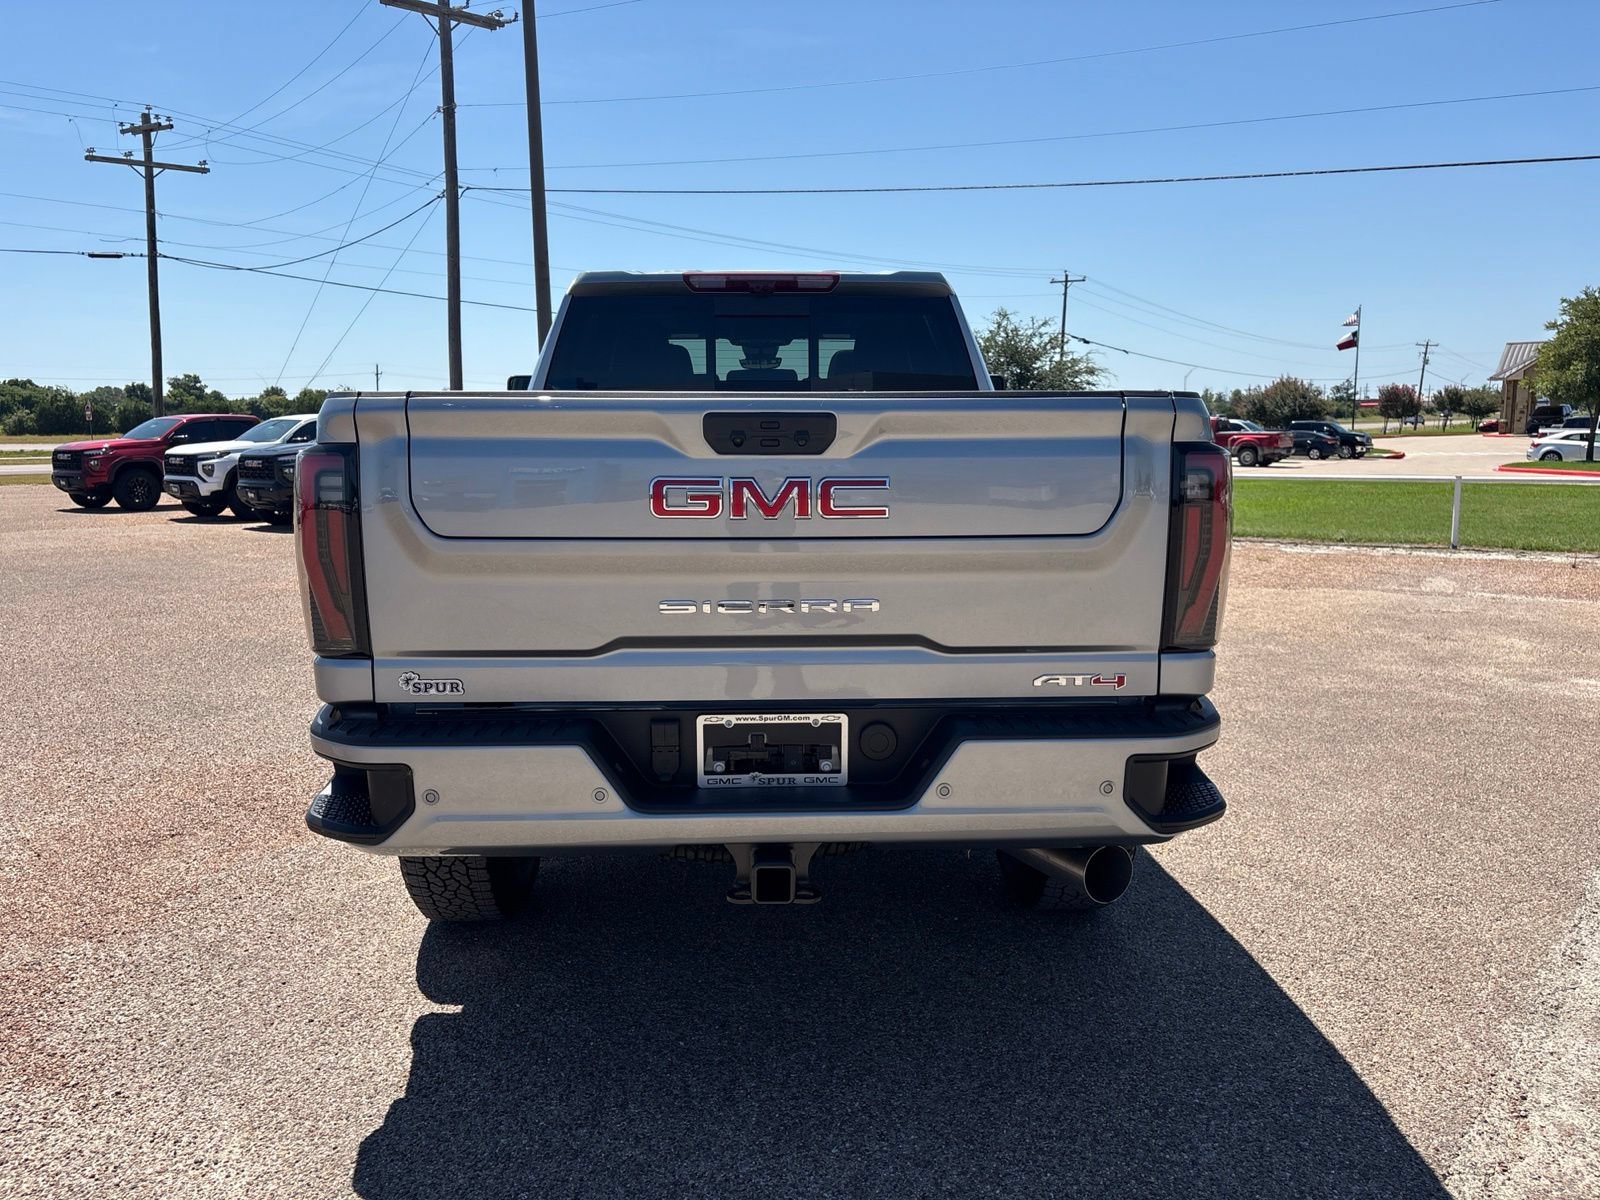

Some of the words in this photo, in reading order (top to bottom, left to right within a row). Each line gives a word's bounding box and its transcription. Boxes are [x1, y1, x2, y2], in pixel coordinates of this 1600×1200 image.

[650, 476, 890, 520] GMC
[658, 599, 880, 614] SIERRA
[412, 682, 461, 693] SPUR
[1032, 673, 1127, 690] AT4
[735, 714, 811, 723] www.SpurGM.com
[758, 777, 797, 786] SPUR
[803, 776, 839, 784] GMC
